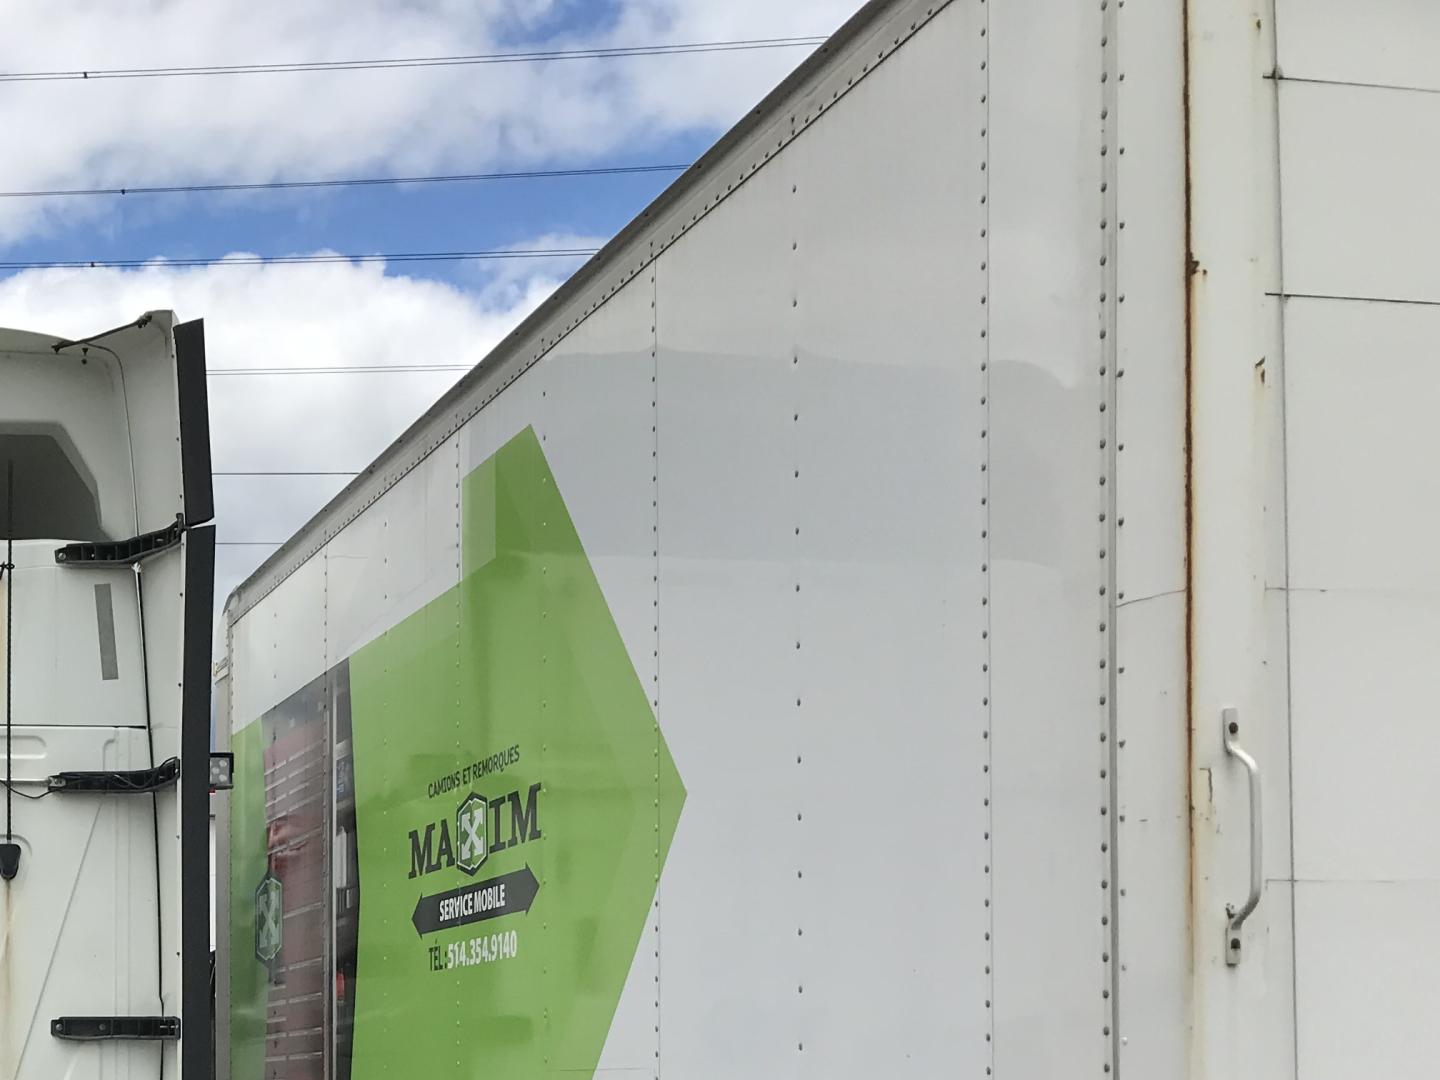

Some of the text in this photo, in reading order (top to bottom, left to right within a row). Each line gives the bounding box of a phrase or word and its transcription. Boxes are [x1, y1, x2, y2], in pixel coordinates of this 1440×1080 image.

[428, 744, 520, 799] CAMIONS ET REMORQUES
[408, 782, 541, 879] MAXIM
[440, 884, 505, 921] SERVICE MOBILE
